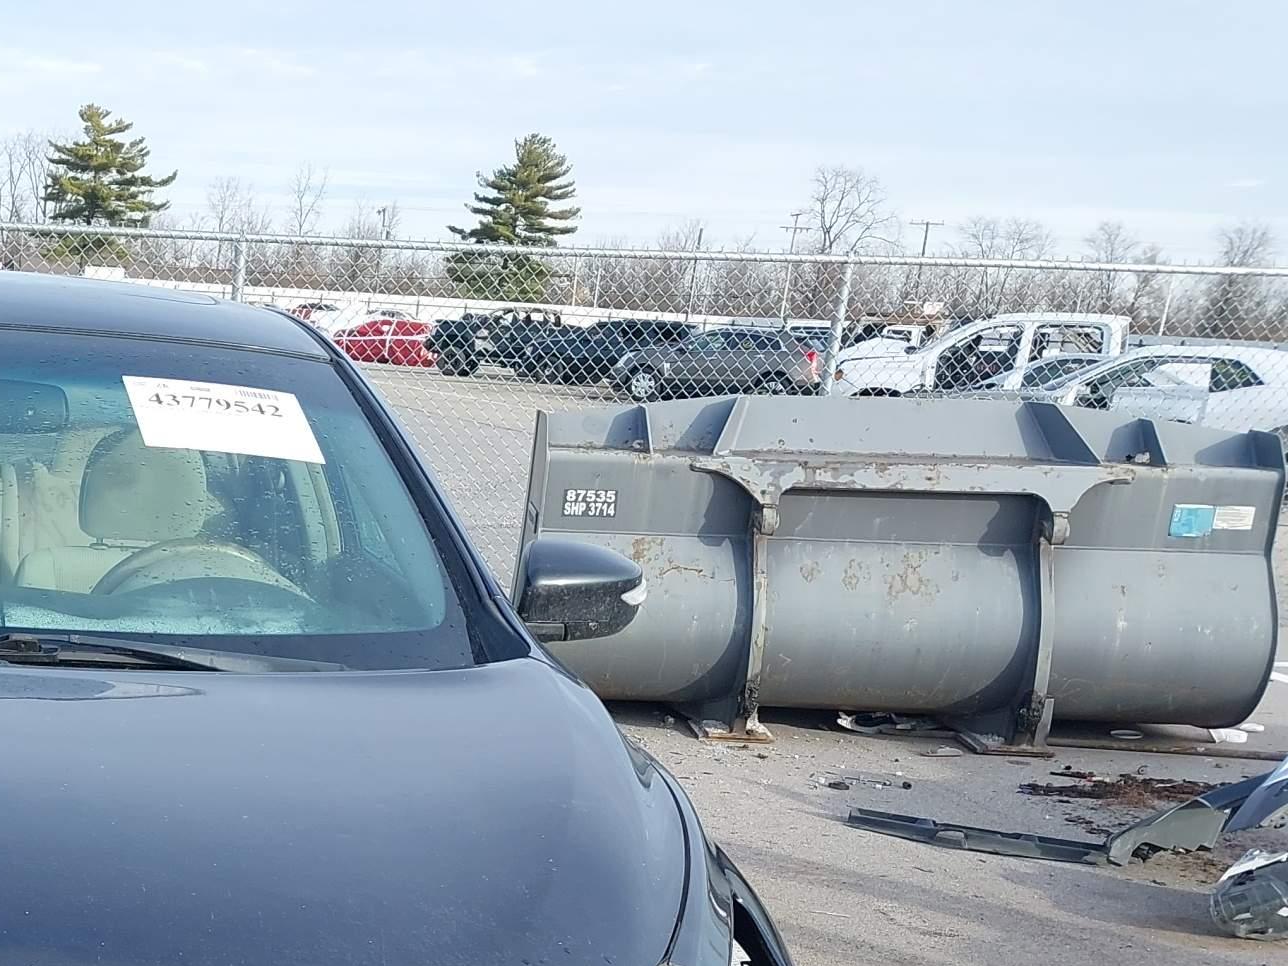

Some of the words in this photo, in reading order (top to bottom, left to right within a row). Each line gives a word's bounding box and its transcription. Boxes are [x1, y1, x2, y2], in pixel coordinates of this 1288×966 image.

[148, 392, 283, 418] 43779542
[566, 489, 616, 502] 87535
[563, 502, 587, 516] SHP
[588, 502, 615, 517] 3714
